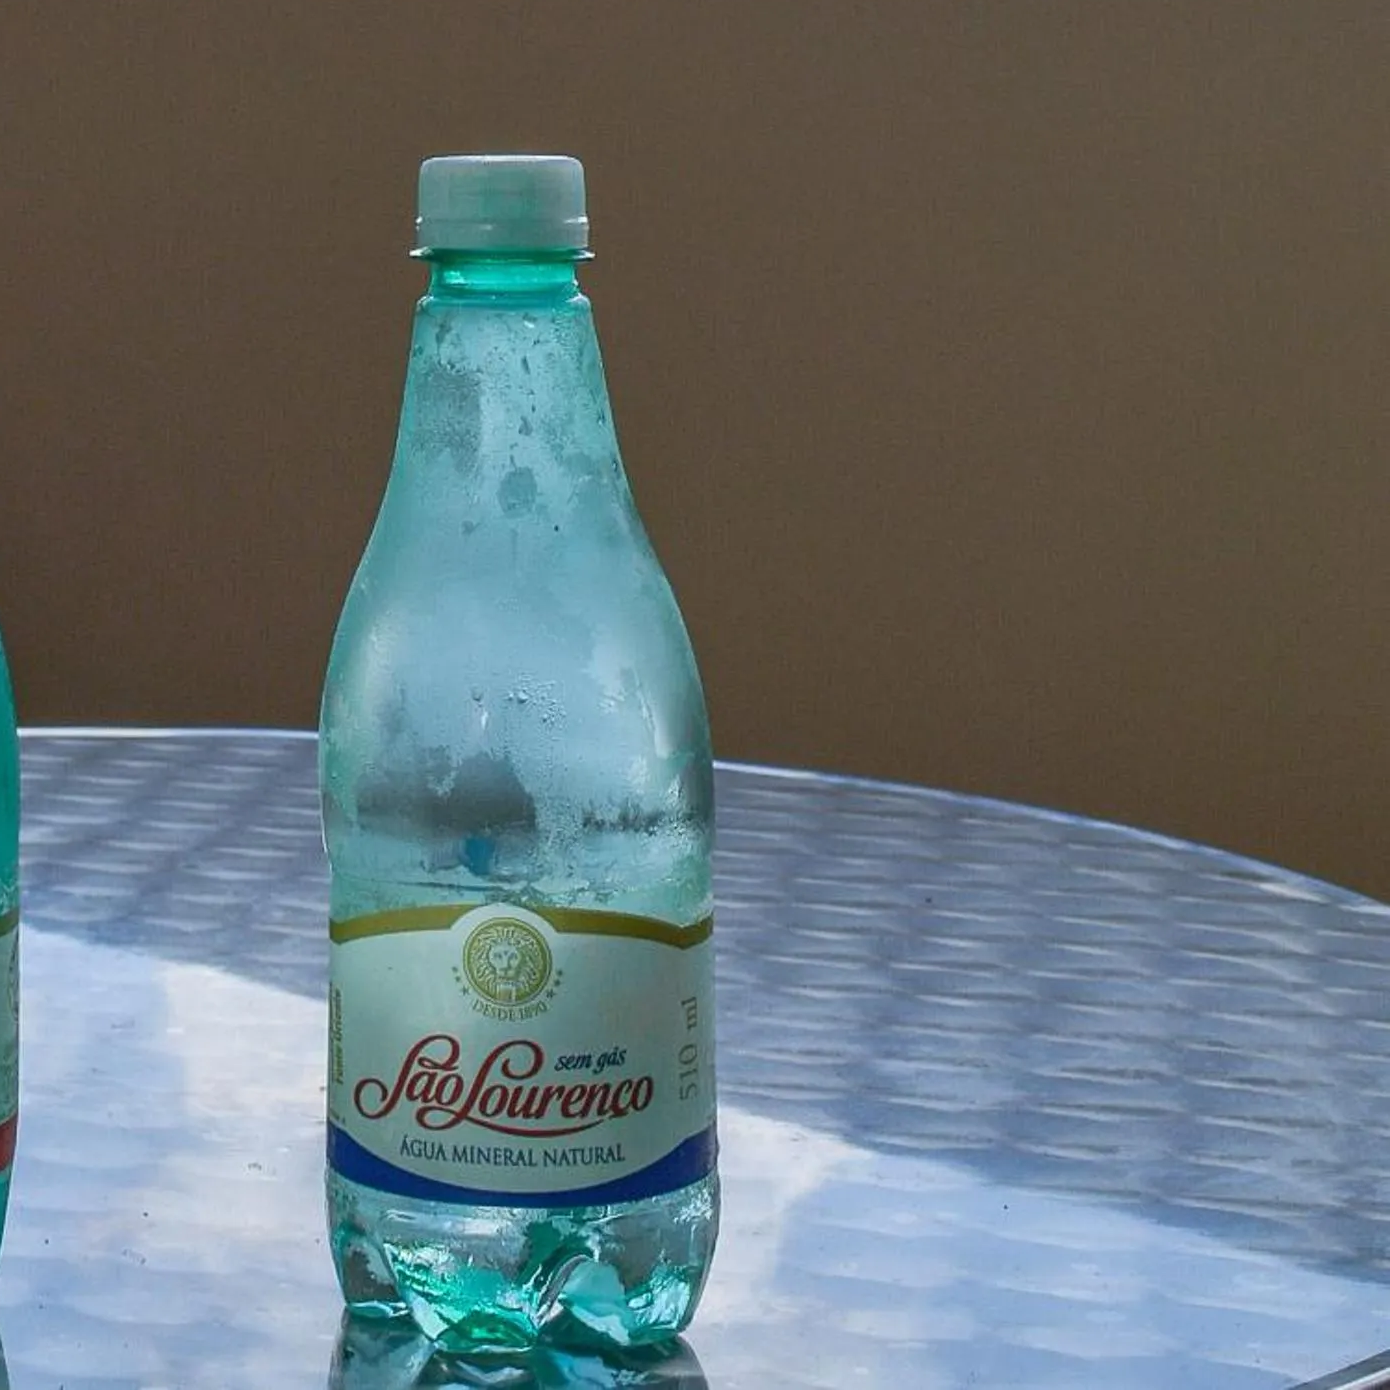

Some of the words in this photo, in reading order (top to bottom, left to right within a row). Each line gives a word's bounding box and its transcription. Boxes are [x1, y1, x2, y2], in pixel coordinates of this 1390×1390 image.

[680, 996, 698, 1031] ml
[554, 1053, 592, 1071] sem
[592, 1046, 627, 1075] gás
[678, 1043, 698, 1101] 510
[353, 1033, 464, 1120] São
[416, 1039, 655, 1138] Lourenço
[399, 1134, 447, 1161] ÁGUA
[451, 1144, 538, 1167] MINERAL
[542, 1143, 626, 1168] NATURAL
